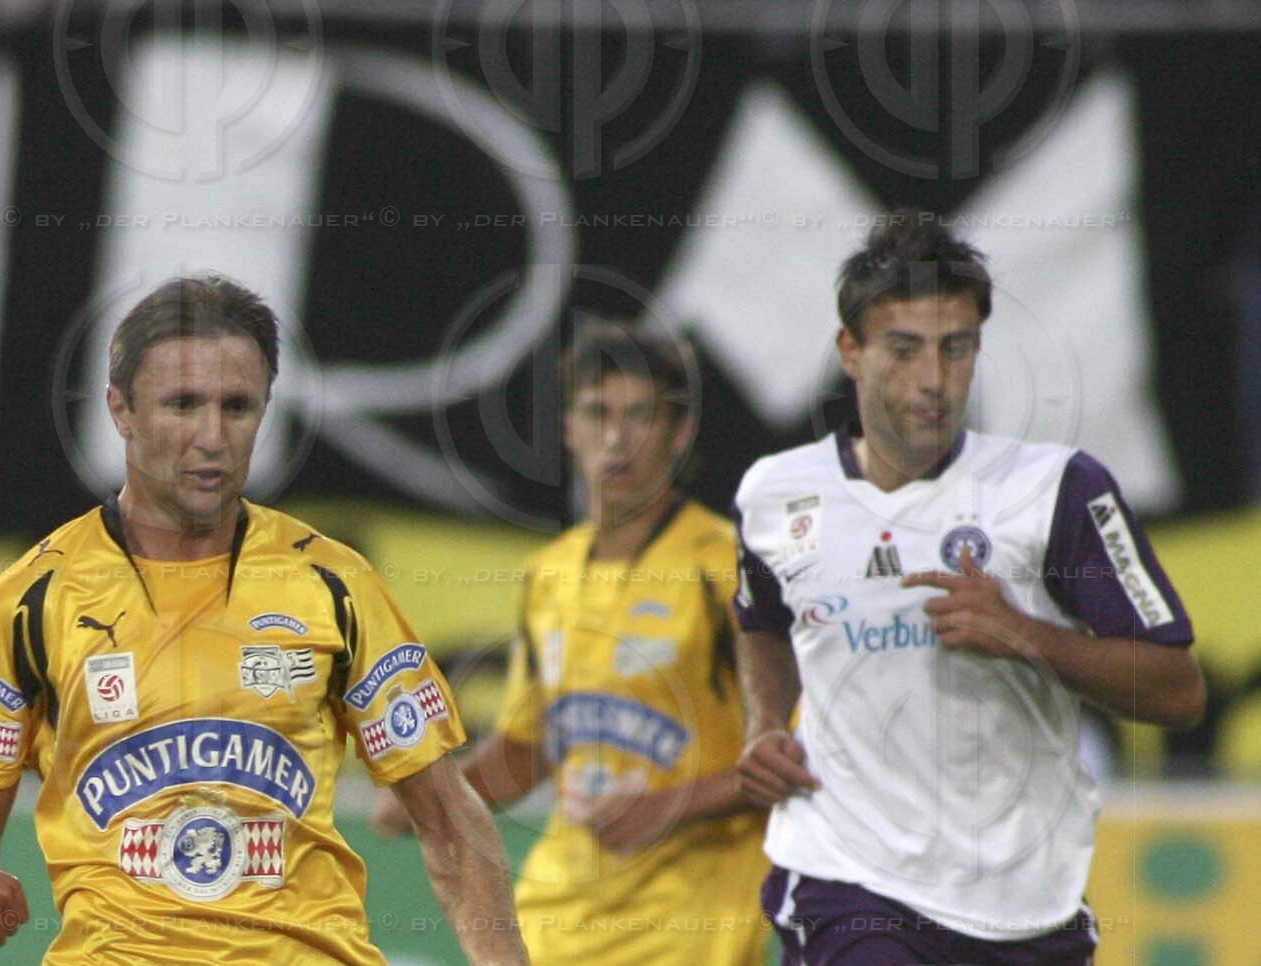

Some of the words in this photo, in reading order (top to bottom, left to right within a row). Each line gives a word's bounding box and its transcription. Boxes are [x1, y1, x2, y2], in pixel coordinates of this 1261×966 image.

[350, 648, 422, 705] PUNTIGAMER
[94, 708, 135, 721] LIGA
[83, 731, 309, 817] PUNTIGAMER
